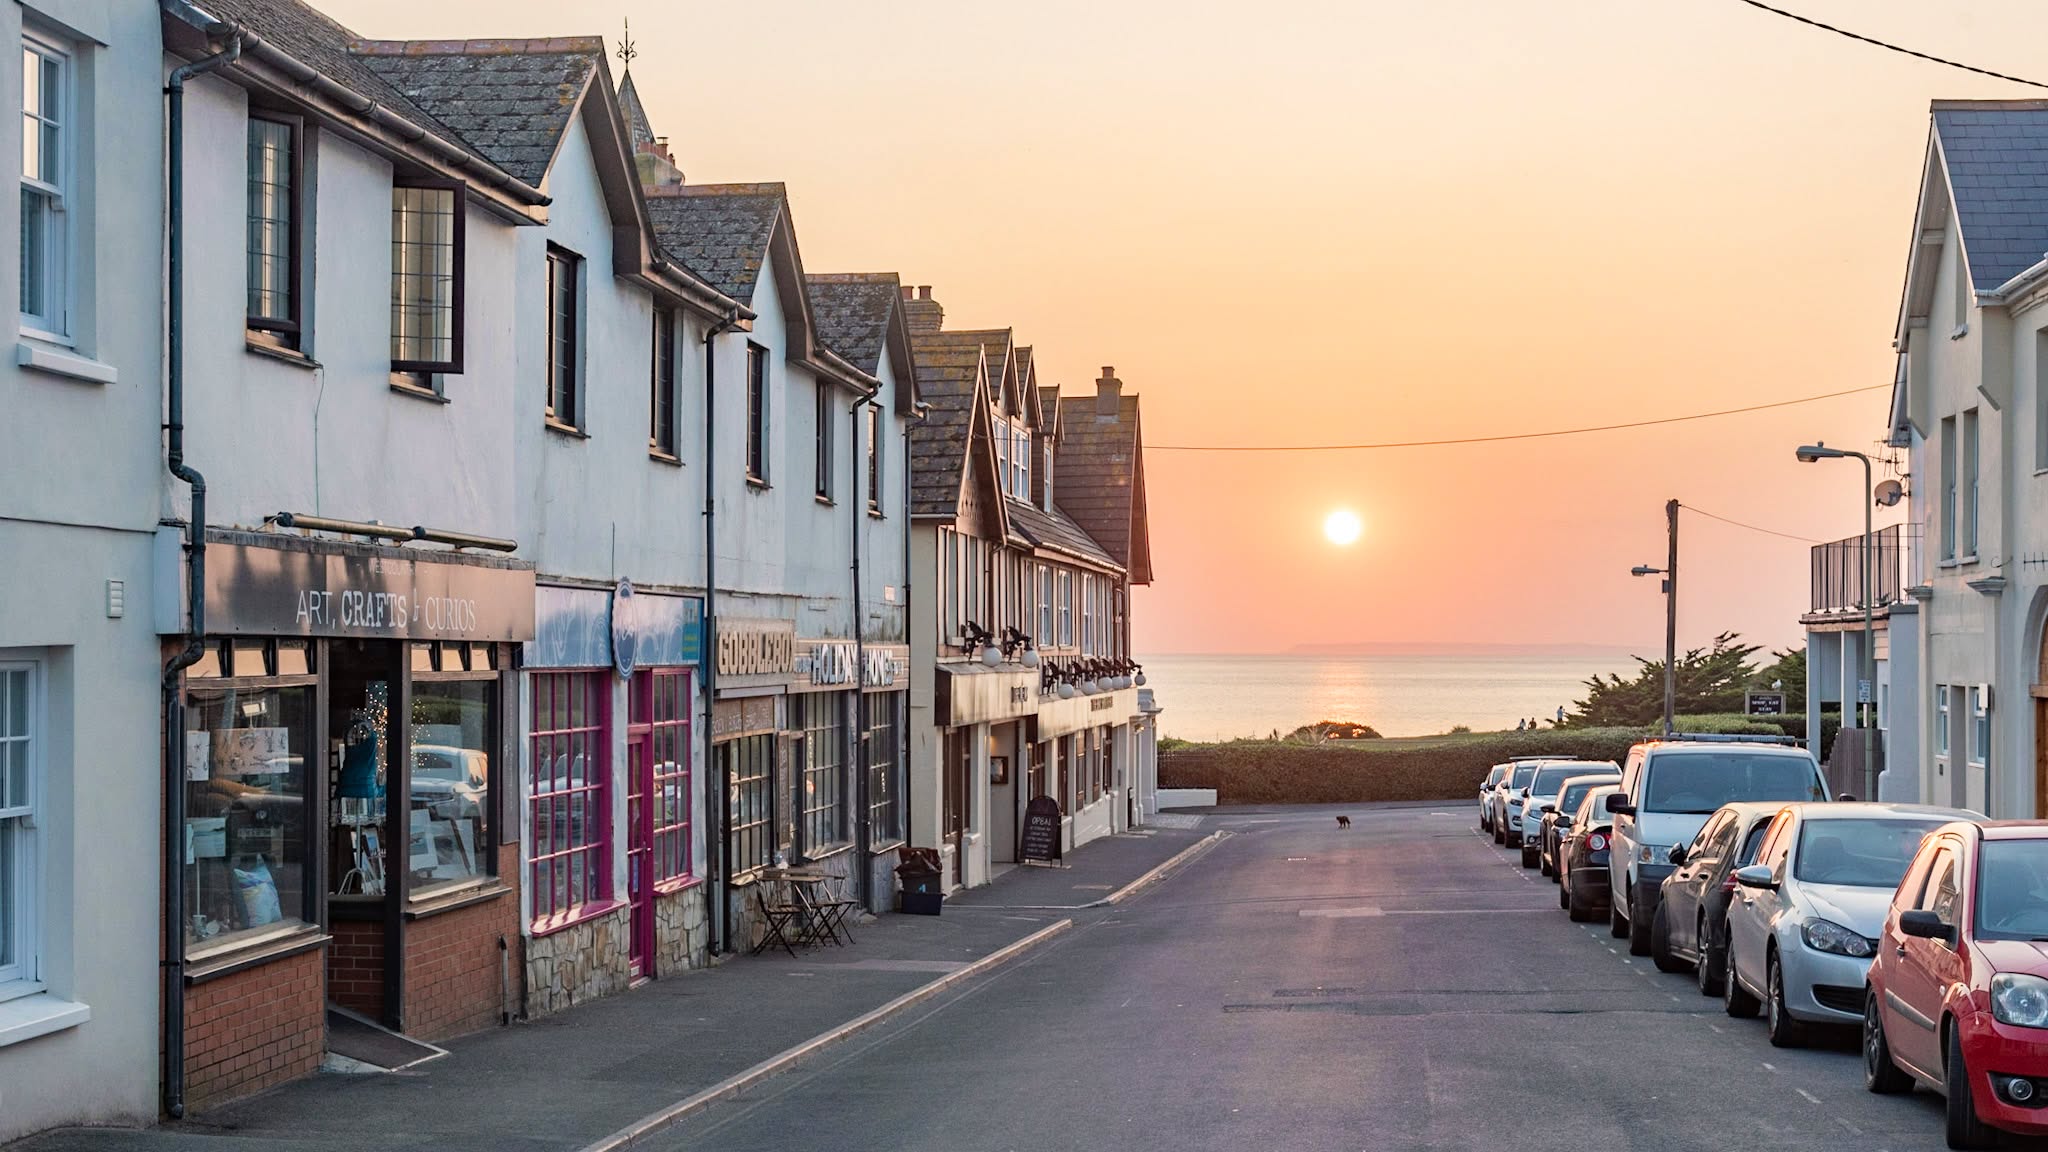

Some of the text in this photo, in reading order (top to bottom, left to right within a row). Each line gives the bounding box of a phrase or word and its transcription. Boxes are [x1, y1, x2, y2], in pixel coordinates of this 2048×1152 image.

[296, 590, 336, 630] ART,
[341, 589, 408, 628] CRAFTS
[425, 596, 477, 632] CURIOS
[812, 643, 858, 685] HOLIDAY
[1031, 816, 1051, 826] OPEN
